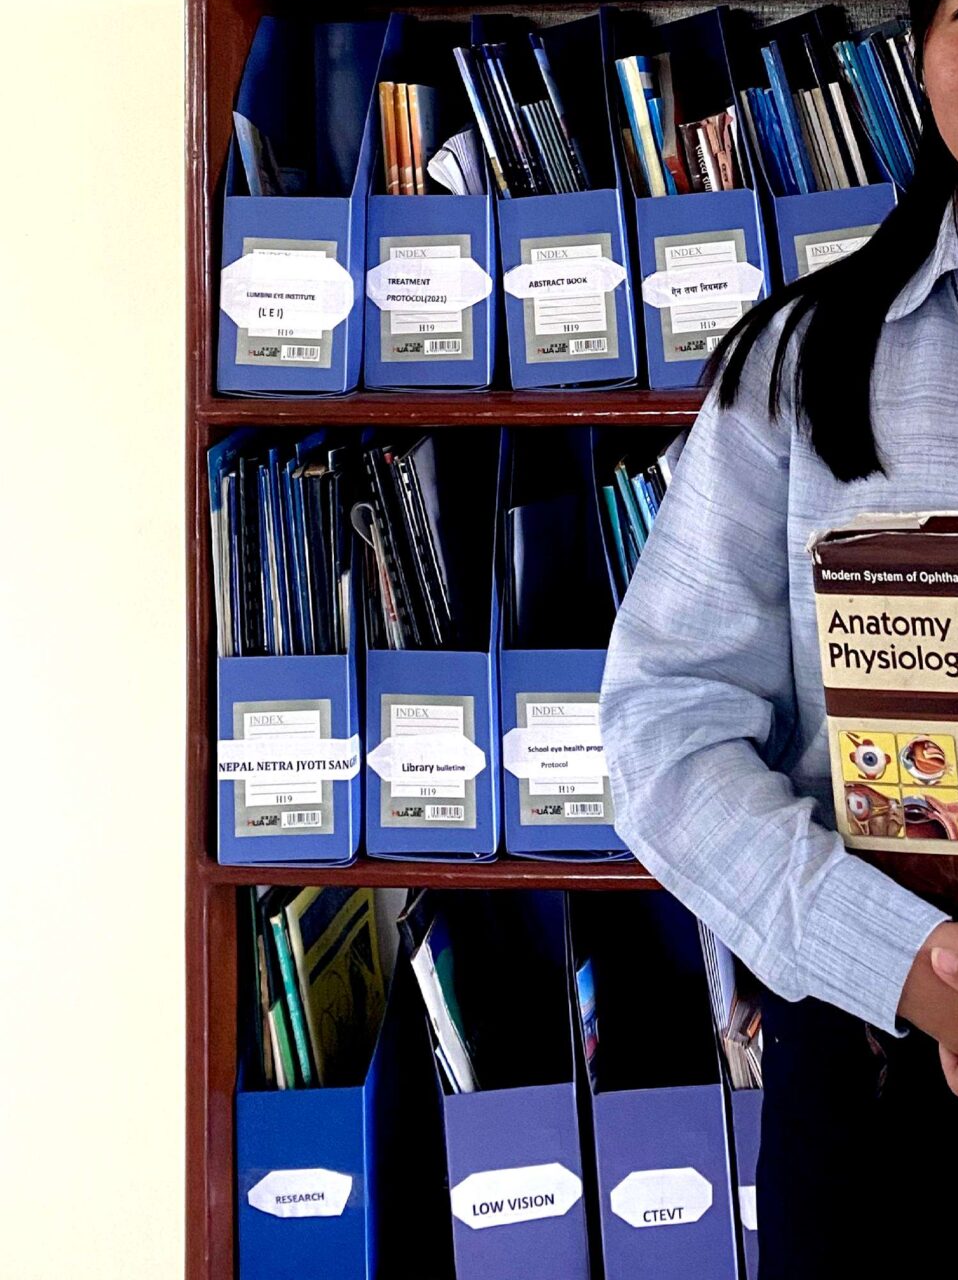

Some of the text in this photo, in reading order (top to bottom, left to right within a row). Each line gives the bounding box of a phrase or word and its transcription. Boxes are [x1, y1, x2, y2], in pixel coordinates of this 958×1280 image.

[395, 249, 427, 258] INDEX
[537, 250, 568, 259] INDEX
[671, 247, 703, 257] INDEX
[811, 244, 843, 256] INDEX
[529, 279, 564, 288] ABSTRACT
[387, 295, 447, 303] PROTOCOL(2021)
[269, 308, 274, 317] E
[564, 324, 579, 332] H19
[700, 321, 716, 329] H19
[822, 570, 861, 581] Modern
[864, 572, 903, 583] System
[906, 572, 917, 582] of
[828, 610, 951, 642] Anatomy
[396, 708, 429, 718] INDEX
[532, 706, 565, 715] INDEX
[250, 715, 284, 726] INDEX
[219, 762, 254, 772] NEPAL
[257, 761, 293, 771] NETRA
[297, 760, 326, 772] JYOTI
[402, 763, 434, 774] Library
[421, 788, 436, 796] H19
[275, 1192, 325, 1204] RESEARCH
[472, 1193, 555, 1216] LOW VISION
[642, 1207, 684, 1223] CTEVT
